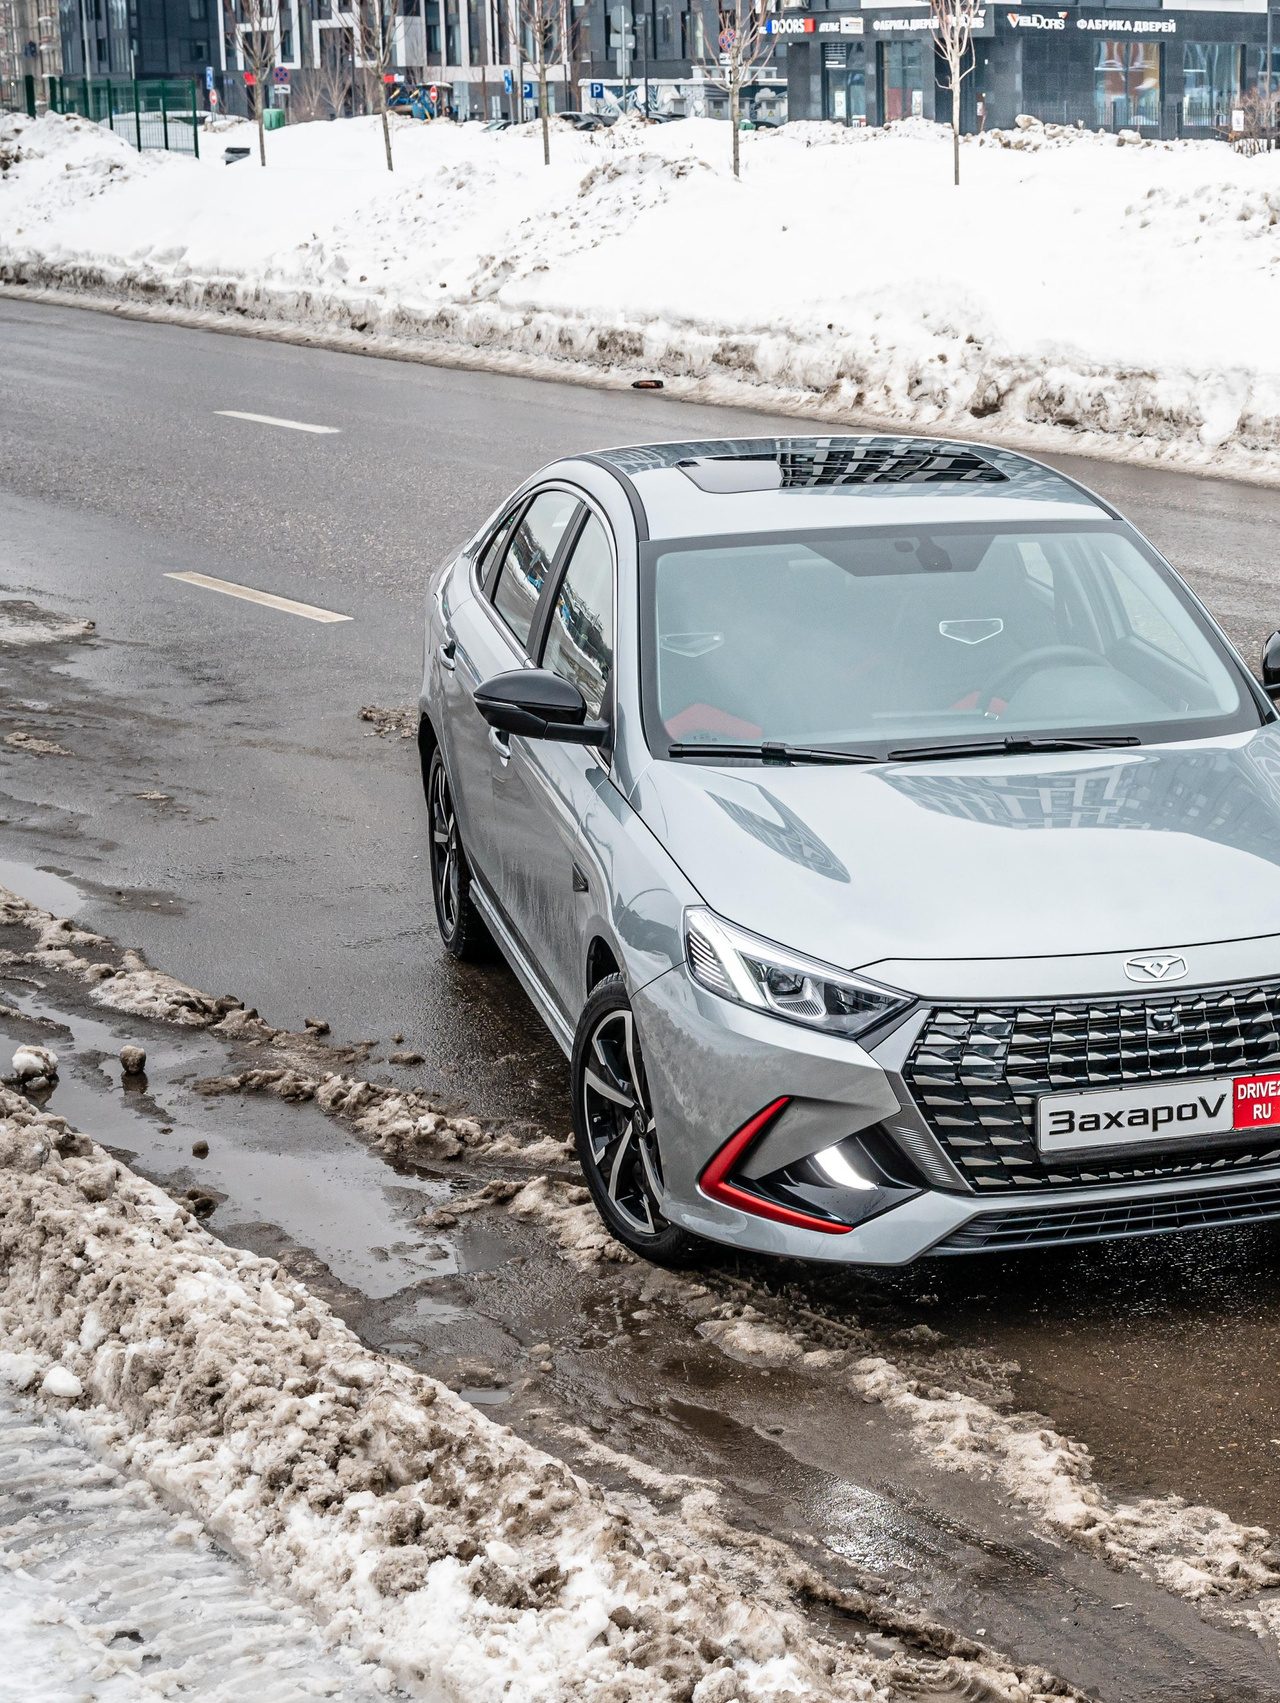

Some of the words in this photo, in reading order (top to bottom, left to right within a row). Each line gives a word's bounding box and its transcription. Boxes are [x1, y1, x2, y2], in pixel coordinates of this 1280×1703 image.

[771, 18, 805, 34] DOORS
[1076, 19, 1132, 32] ФАБРИКА
[1133, 19, 1176, 33] ДВЕРЕЙ
[593, 84, 601, 97] P
[1252, 1102, 1272, 1120] RU
